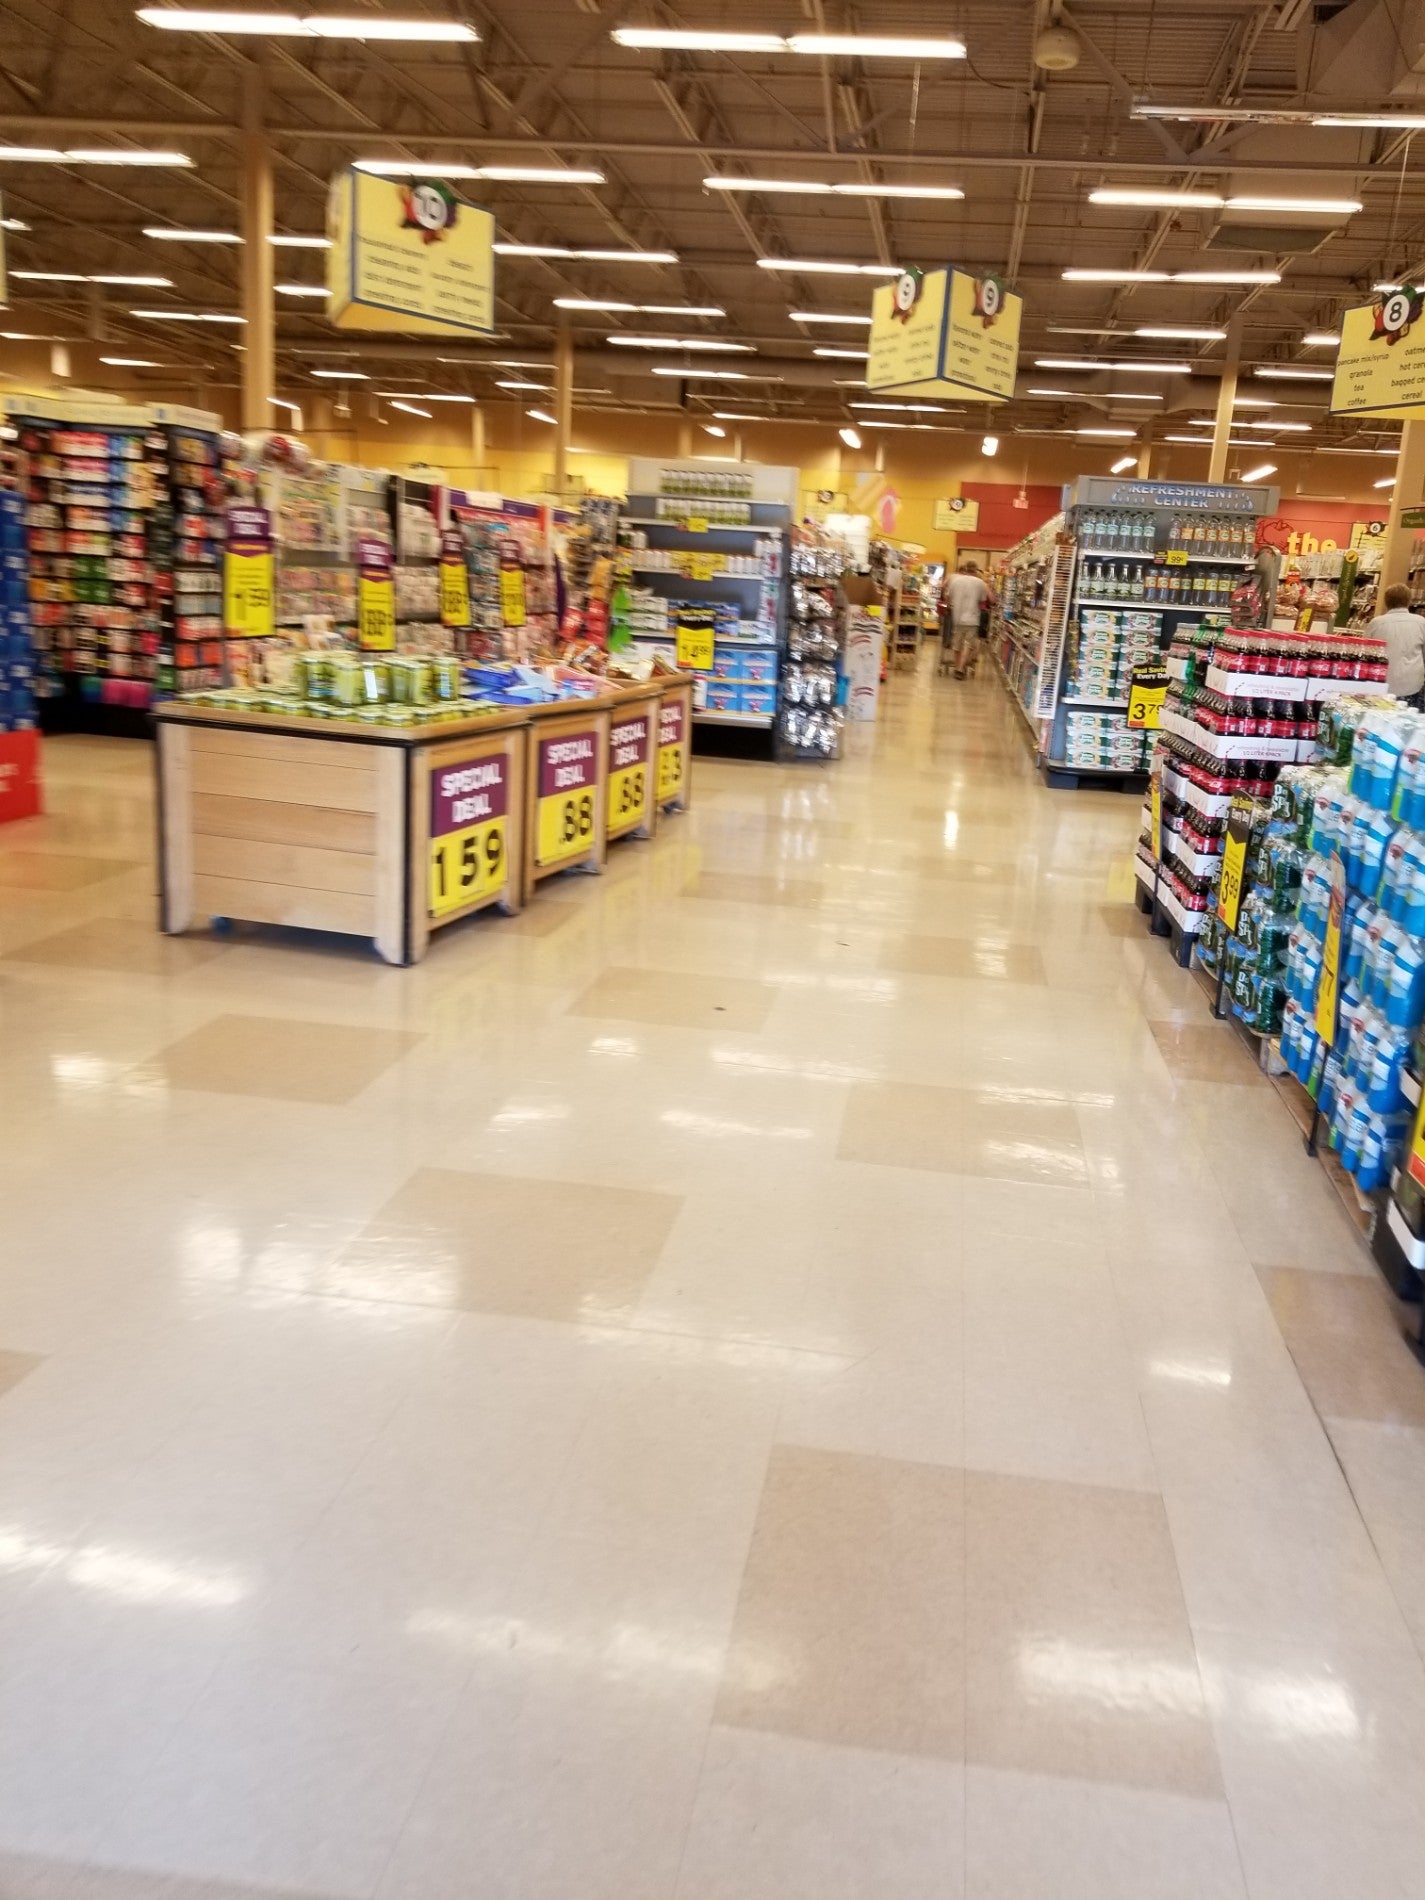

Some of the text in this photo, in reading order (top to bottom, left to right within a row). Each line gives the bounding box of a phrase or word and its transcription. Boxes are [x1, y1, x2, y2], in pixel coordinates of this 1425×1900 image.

[1389, 301, 1402, 322] 8
[1349, 369, 1373, 379] granola
[1391, 376, 1415, 387] bagged
[1347, 398, 1366, 406] coffee
[1402, 390, 1422, 400] cereal
[1131, 485, 1232, 498] REFRESHMENT
[1154, 497, 1208, 507] CENTER
[1287, 532, 1337, 555] the
[1133, 703, 1146, 720] 3
[610, 722, 646, 746] SPECIAL
[547, 740, 593, 764] SPECIAL
[615, 745, 639, 765] DEAL
[440, 763, 502, 797] SPECIAL
[554, 764, 585, 787] DEAL
[452, 794, 492, 823] DEAL
